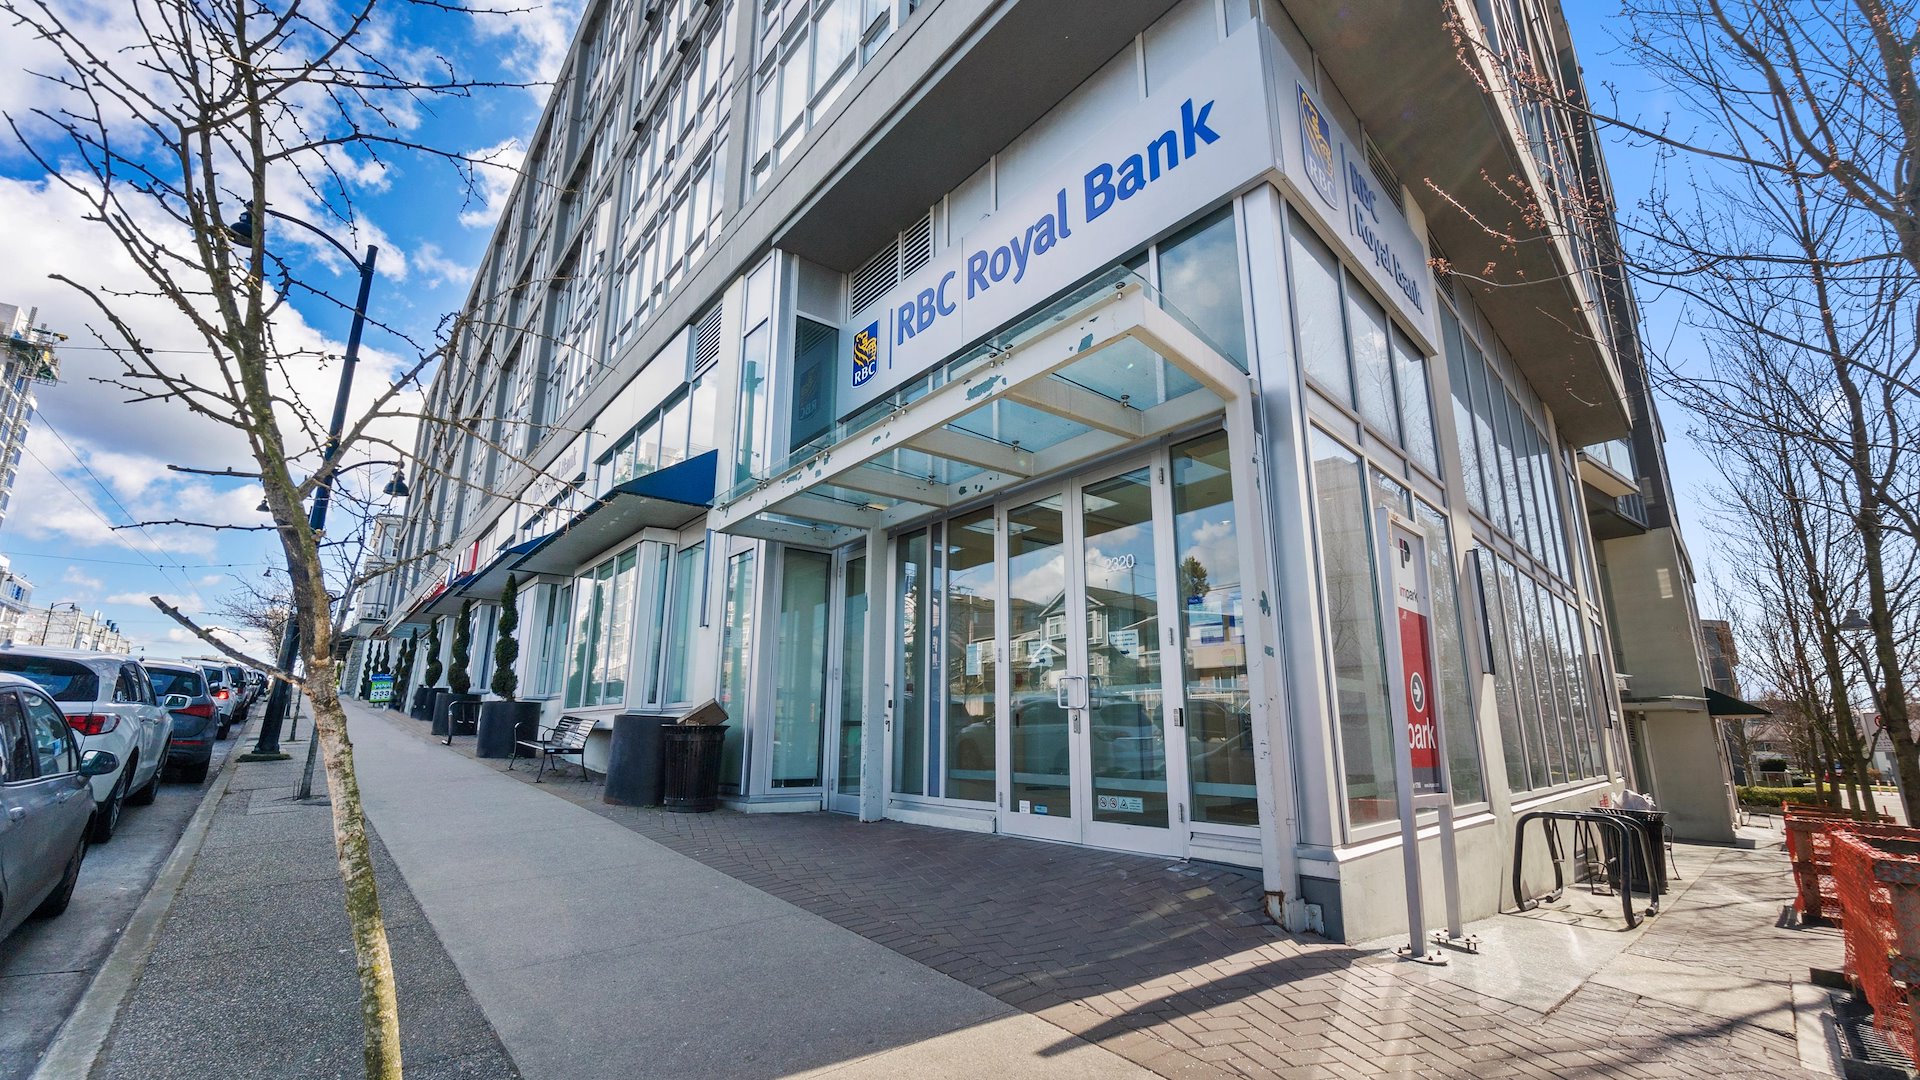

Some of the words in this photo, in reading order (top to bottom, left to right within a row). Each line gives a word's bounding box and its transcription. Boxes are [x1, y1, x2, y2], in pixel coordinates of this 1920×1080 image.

[1307, 157, 1337, 204] RBC
[1349, 161, 1380, 224] RBC
[897, 270, 956, 346] RBC
[967, 187, 1072, 301] Royal
[1084, 97, 1222, 224] Bank
[1354, 203, 1394, 278] Royal
[1392, 252, 1425, 315] Bank
[854, 361, 876, 385] RBC
[1104, 553, 1135, 573] 2320
